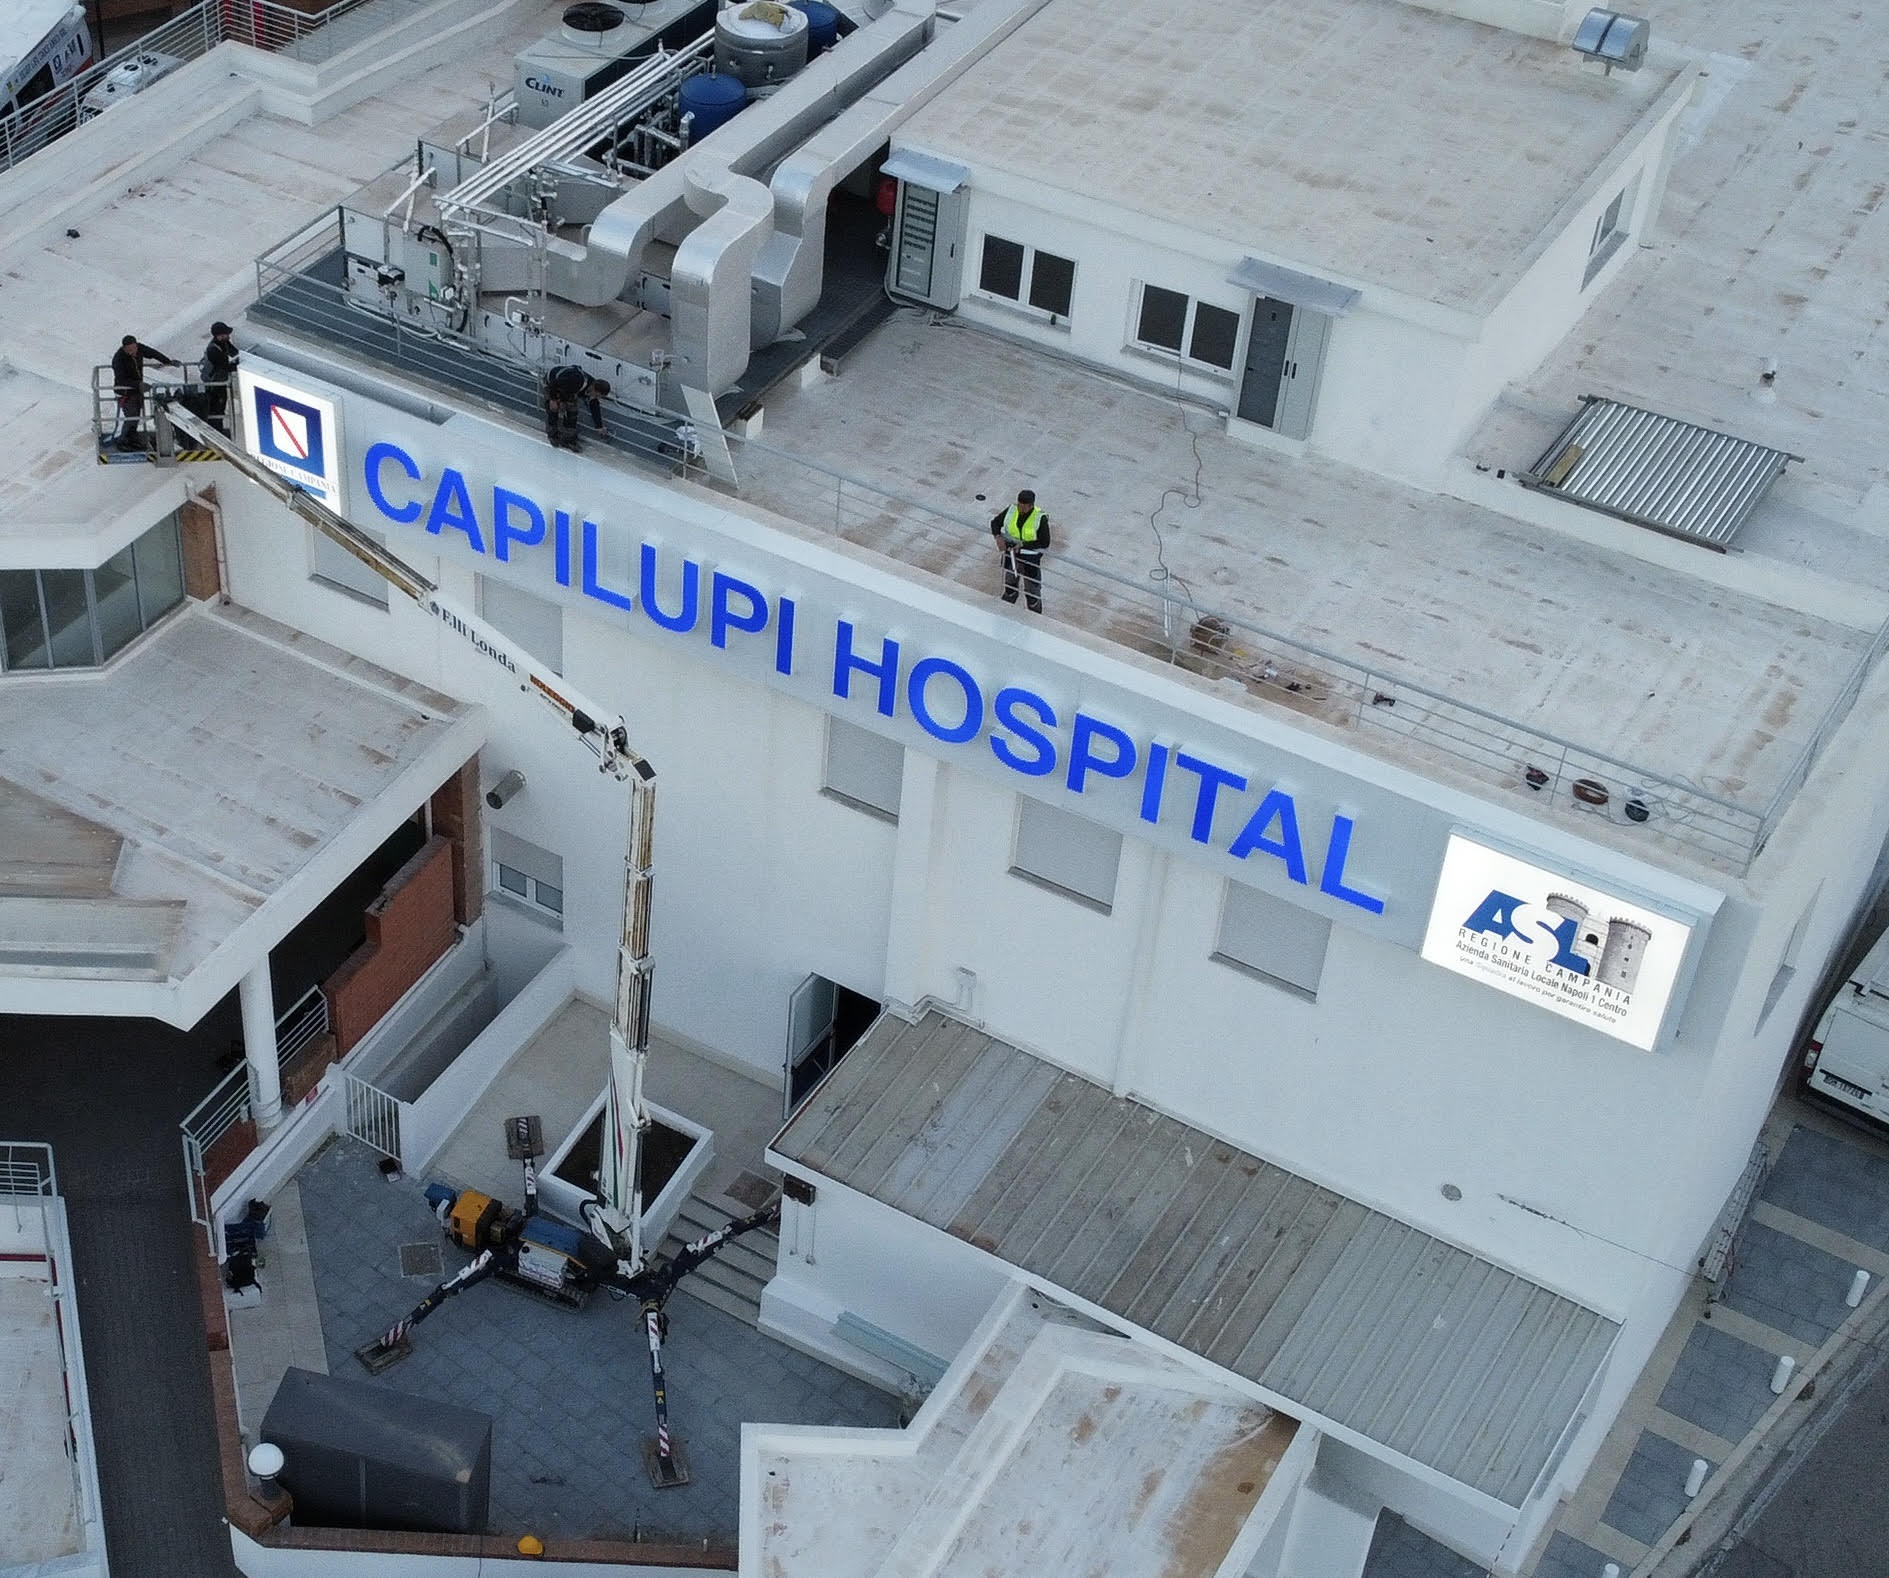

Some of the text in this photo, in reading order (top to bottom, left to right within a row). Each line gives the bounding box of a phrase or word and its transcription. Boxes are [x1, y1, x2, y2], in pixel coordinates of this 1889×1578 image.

[525, 77, 565, 98] CLINT
[365, 442, 1386, 916] CAPILUPI HOSPITAL
[471, 629, 516, 674] Londa
[1458, 928, 1631, 1005] REGIONE CAMPANIA
[1462, 889, 1590, 977] ASL
[1455, 941, 1628, 1017] Azienda Sanitaria Locale Napoli 1 Centro
